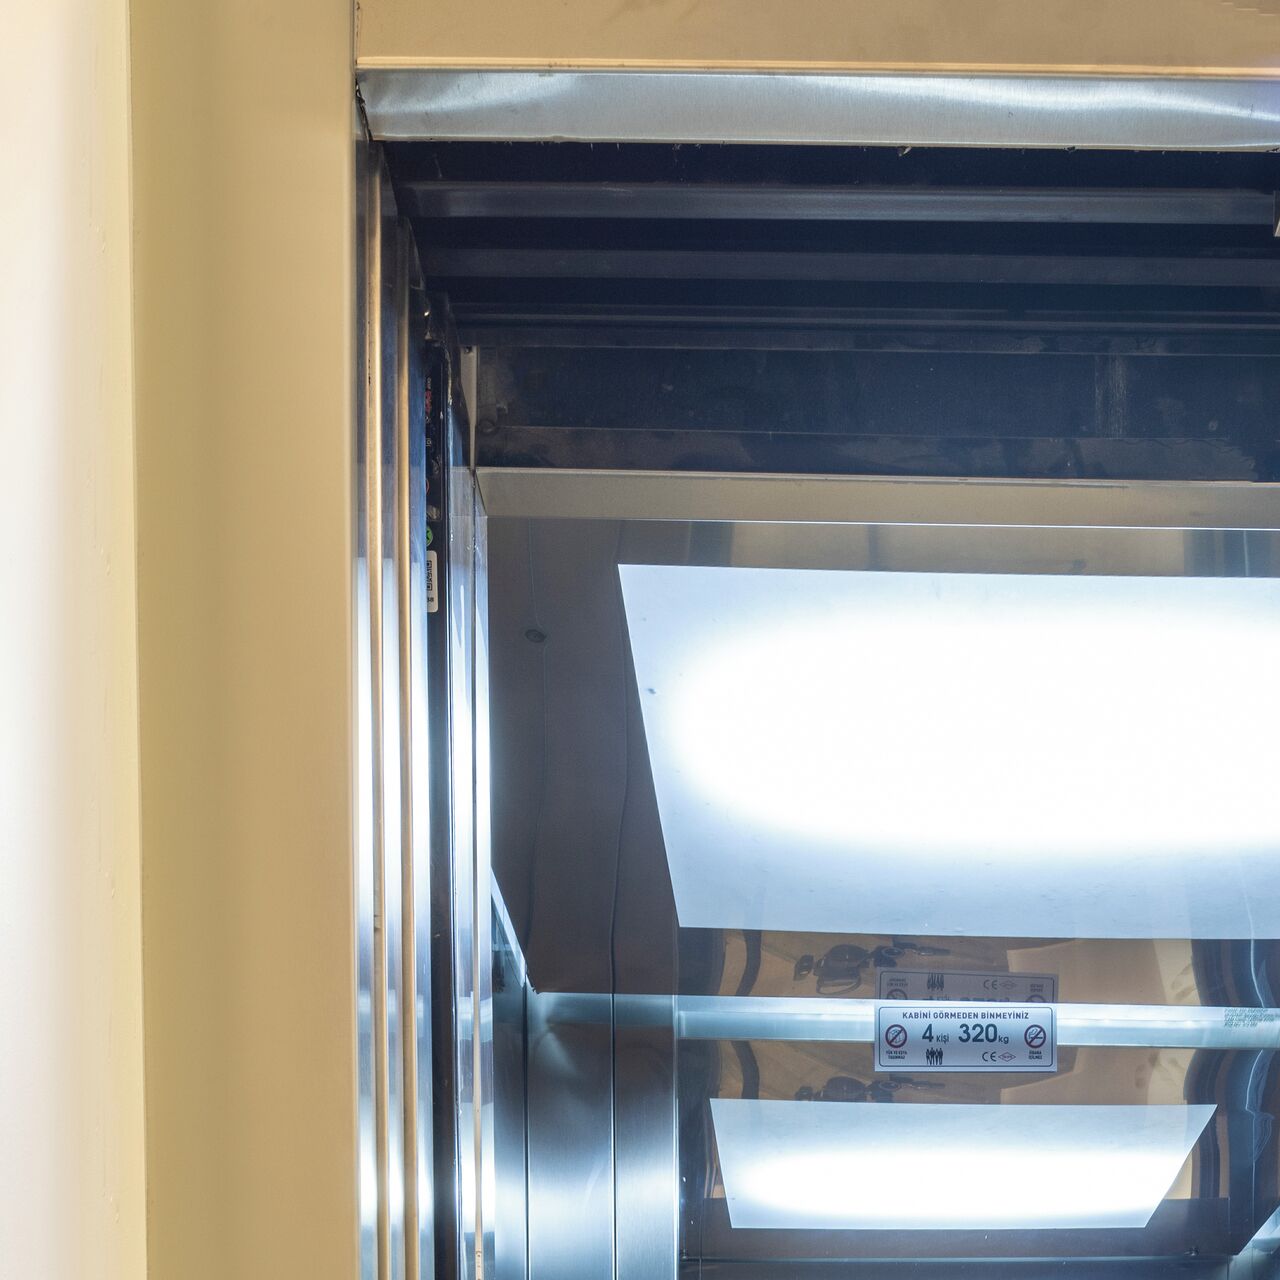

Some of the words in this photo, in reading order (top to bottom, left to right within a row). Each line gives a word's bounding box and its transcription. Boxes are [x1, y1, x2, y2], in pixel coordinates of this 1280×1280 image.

[902, 1010, 931, 1020] KABİNİ
[933, 1010, 979, 1020] GÖRMEDEN
[981, 1010, 1029, 1020] BİNMEYİNİZ
[921, 1023, 934, 1043] 4
[958, 1023, 998, 1043] 320
[998, 1035, 1009, 1045] kg
